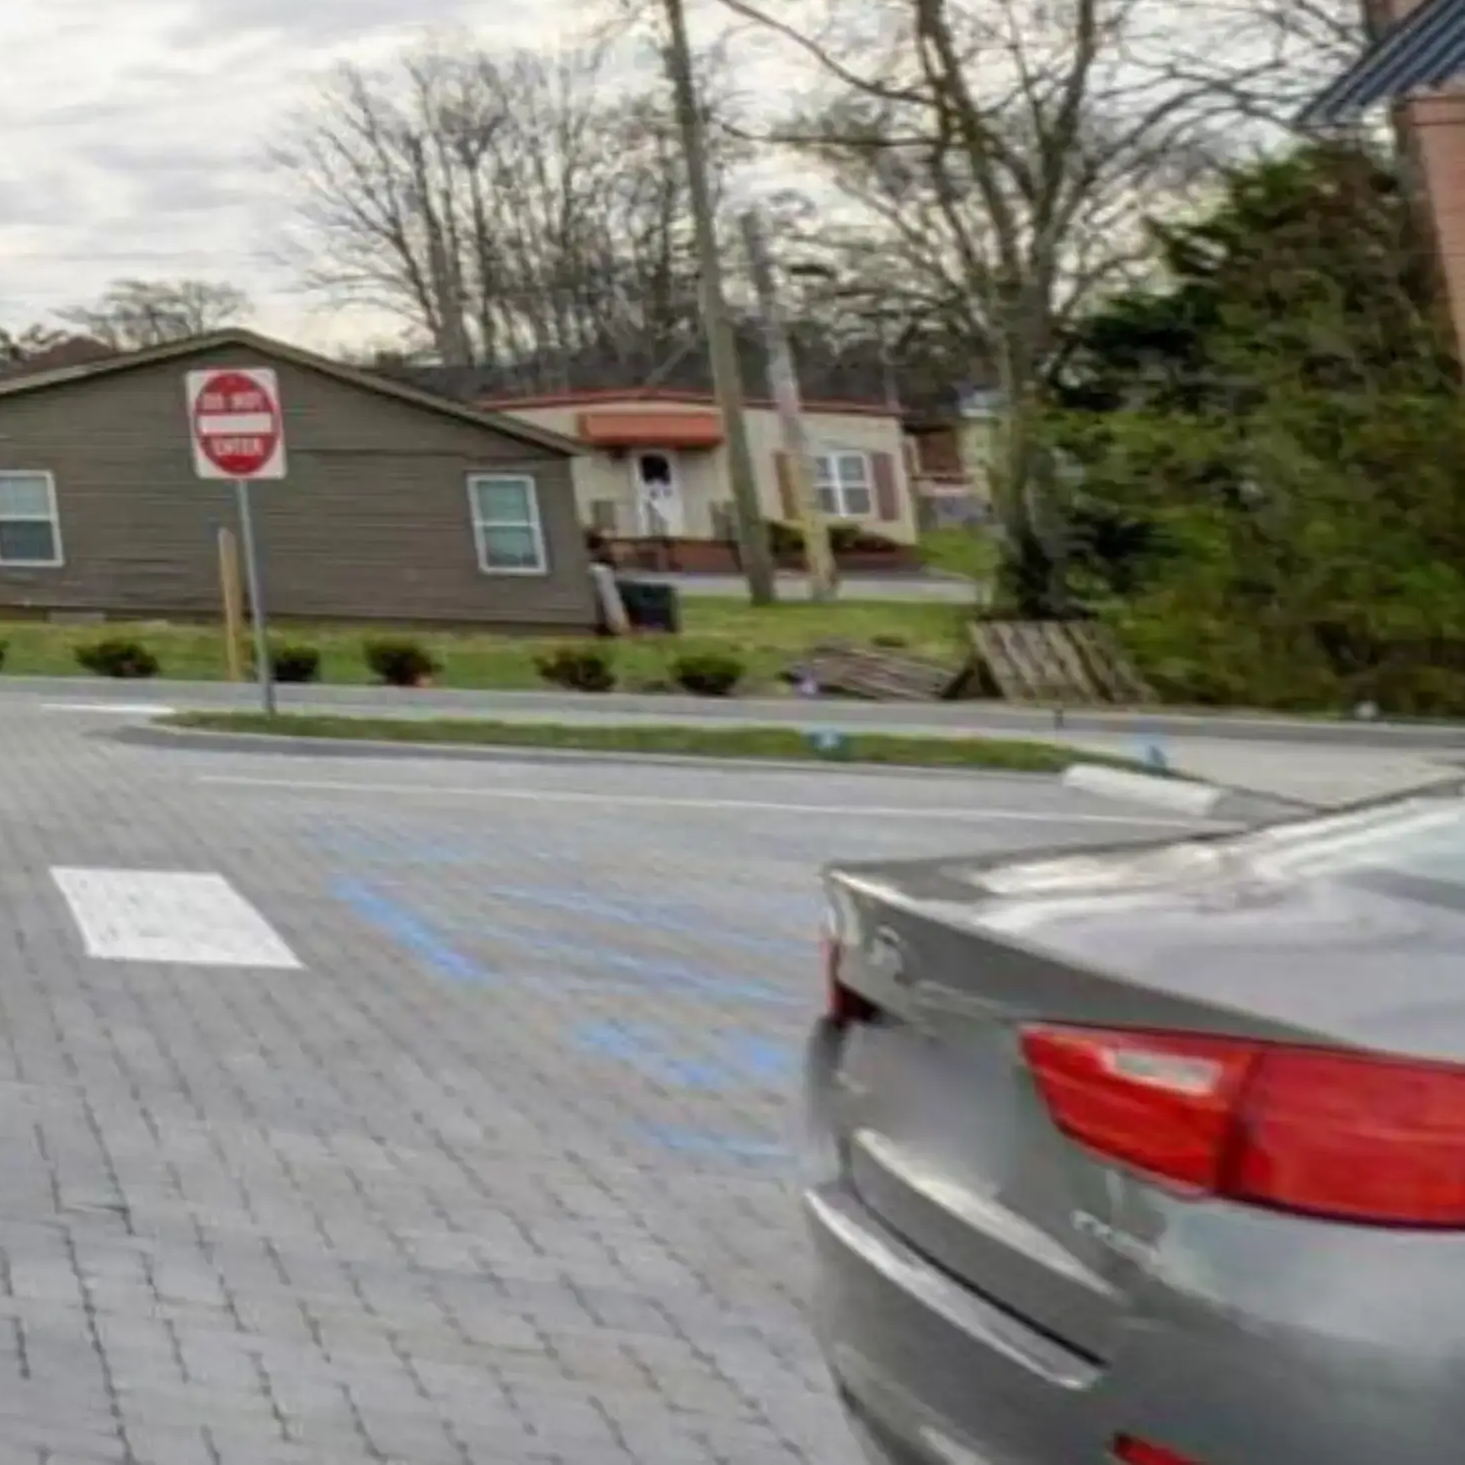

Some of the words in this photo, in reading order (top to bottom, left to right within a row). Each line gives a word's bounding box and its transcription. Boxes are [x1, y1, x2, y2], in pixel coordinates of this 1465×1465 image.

[201, 392, 224, 410] DO
[231, 391, 264, 410] NOT
[210, 436, 265, 457] ENTER
